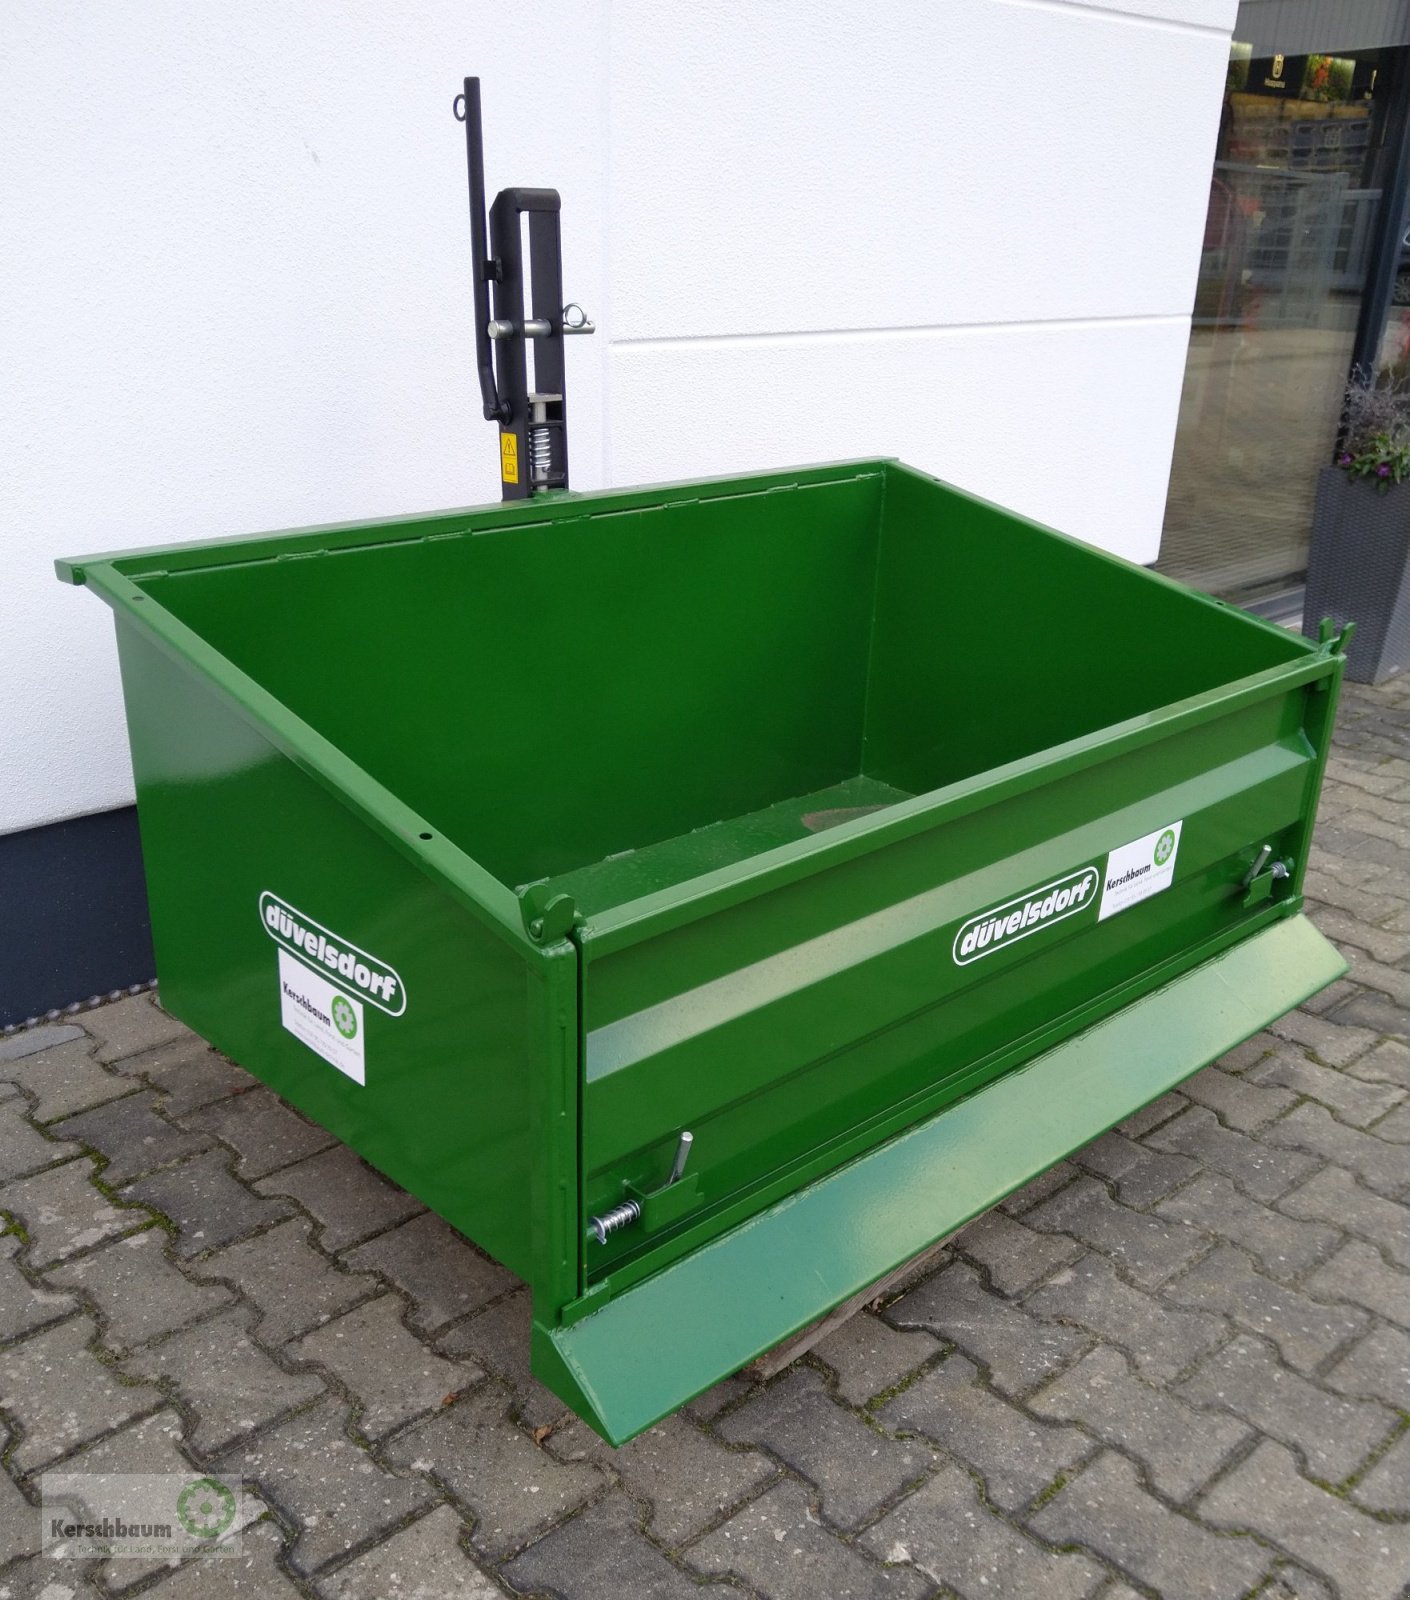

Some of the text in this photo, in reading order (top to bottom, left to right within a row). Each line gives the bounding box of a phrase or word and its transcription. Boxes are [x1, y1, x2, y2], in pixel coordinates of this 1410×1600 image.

[1106, 864, 1151, 892] Kerschbaum
[960, 874, 1093, 956] düvelsdorf
[265, 904, 397, 1002] düvelsdorf
[282, 980, 331, 1027] Kerschbaum
